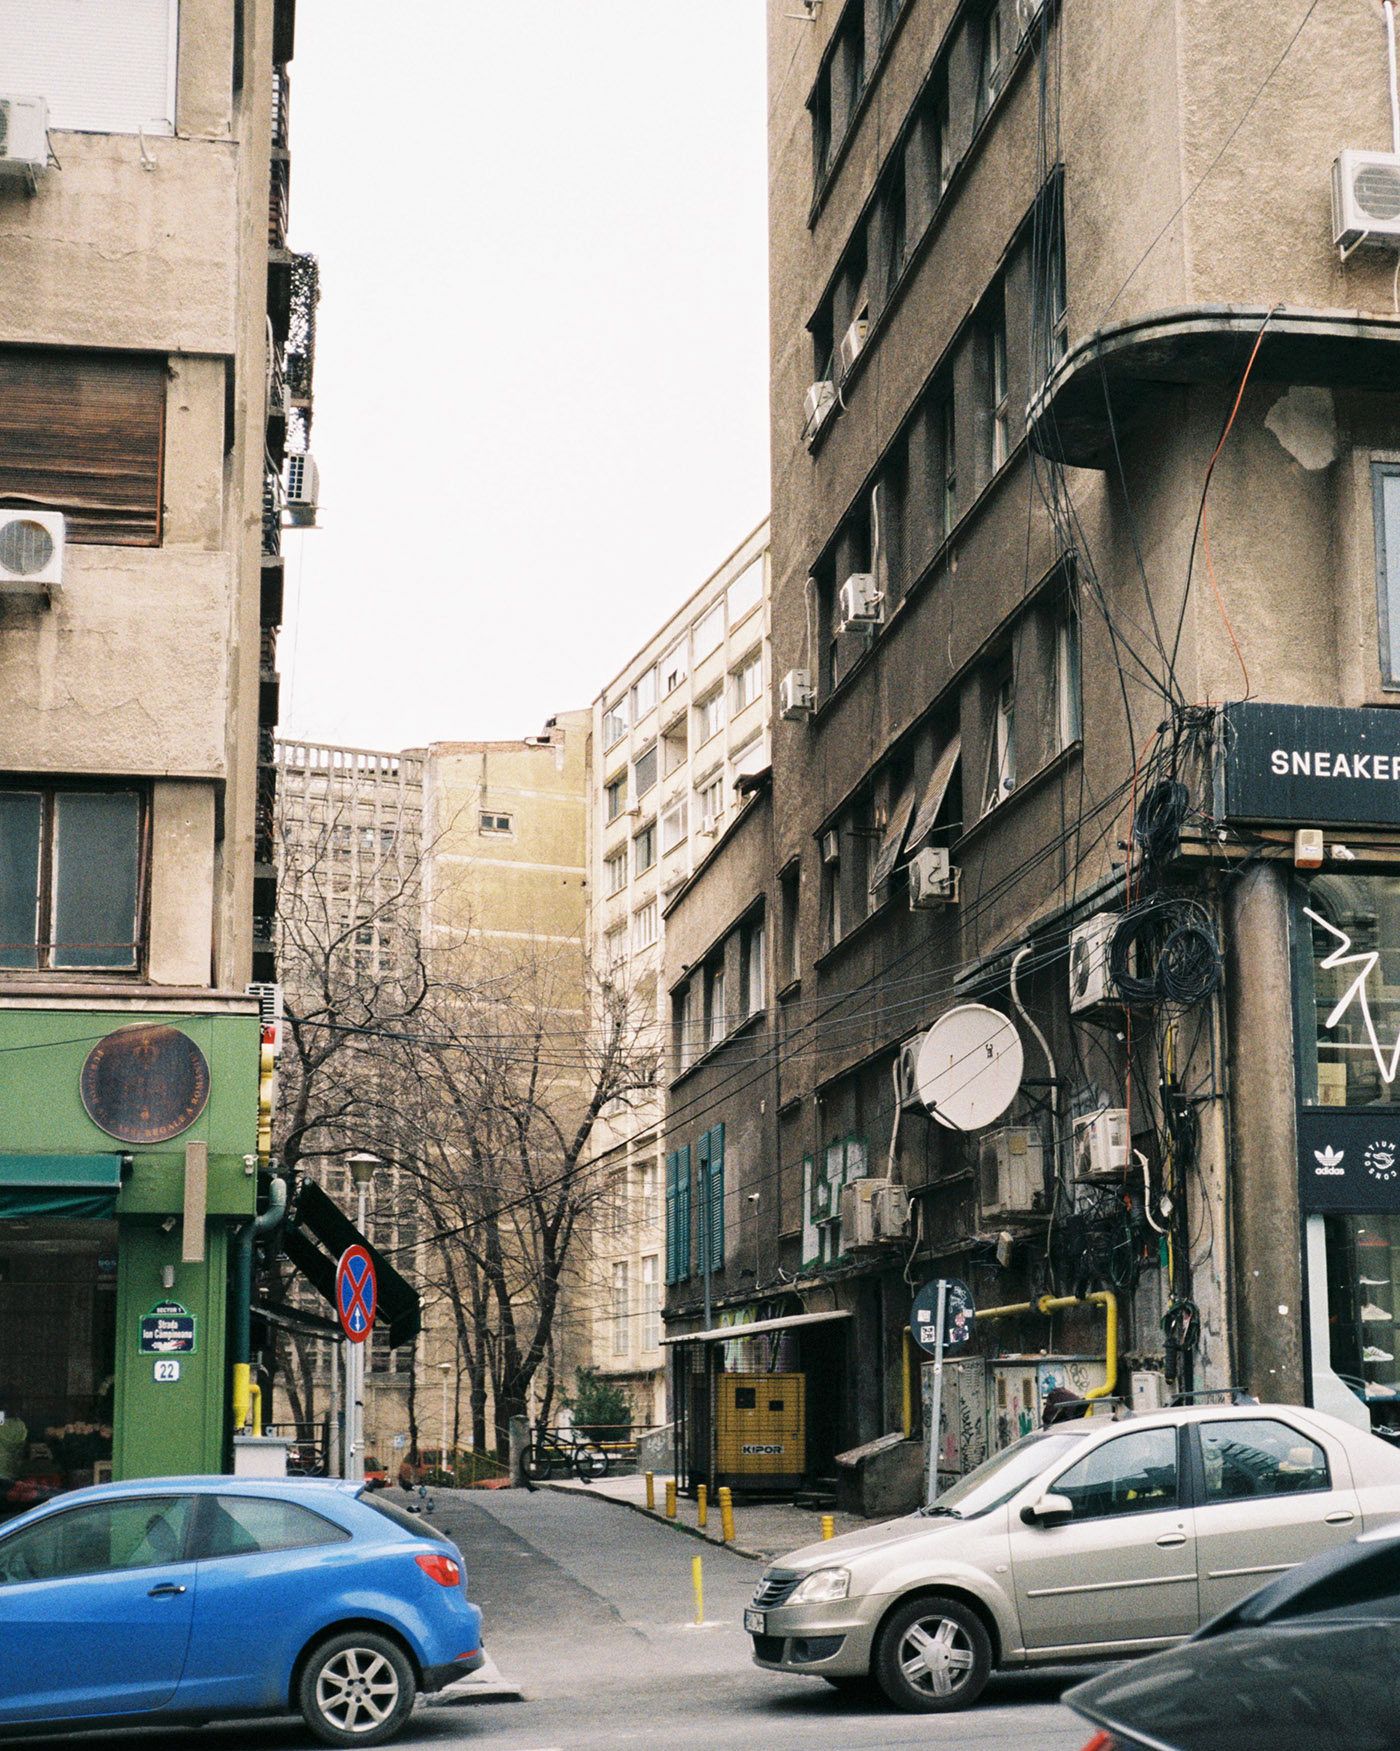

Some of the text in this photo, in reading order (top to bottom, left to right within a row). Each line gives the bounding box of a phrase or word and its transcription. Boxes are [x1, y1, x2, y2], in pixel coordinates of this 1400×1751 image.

[1315, 1167, 1345, 1176] adidas
[157, 1319, 179, 1329] Strada
[143, 1329, 153, 1339] Ion
[160, 1363, 174, 1379] 22
[742, 1446, 783, 1454] KIPOR
